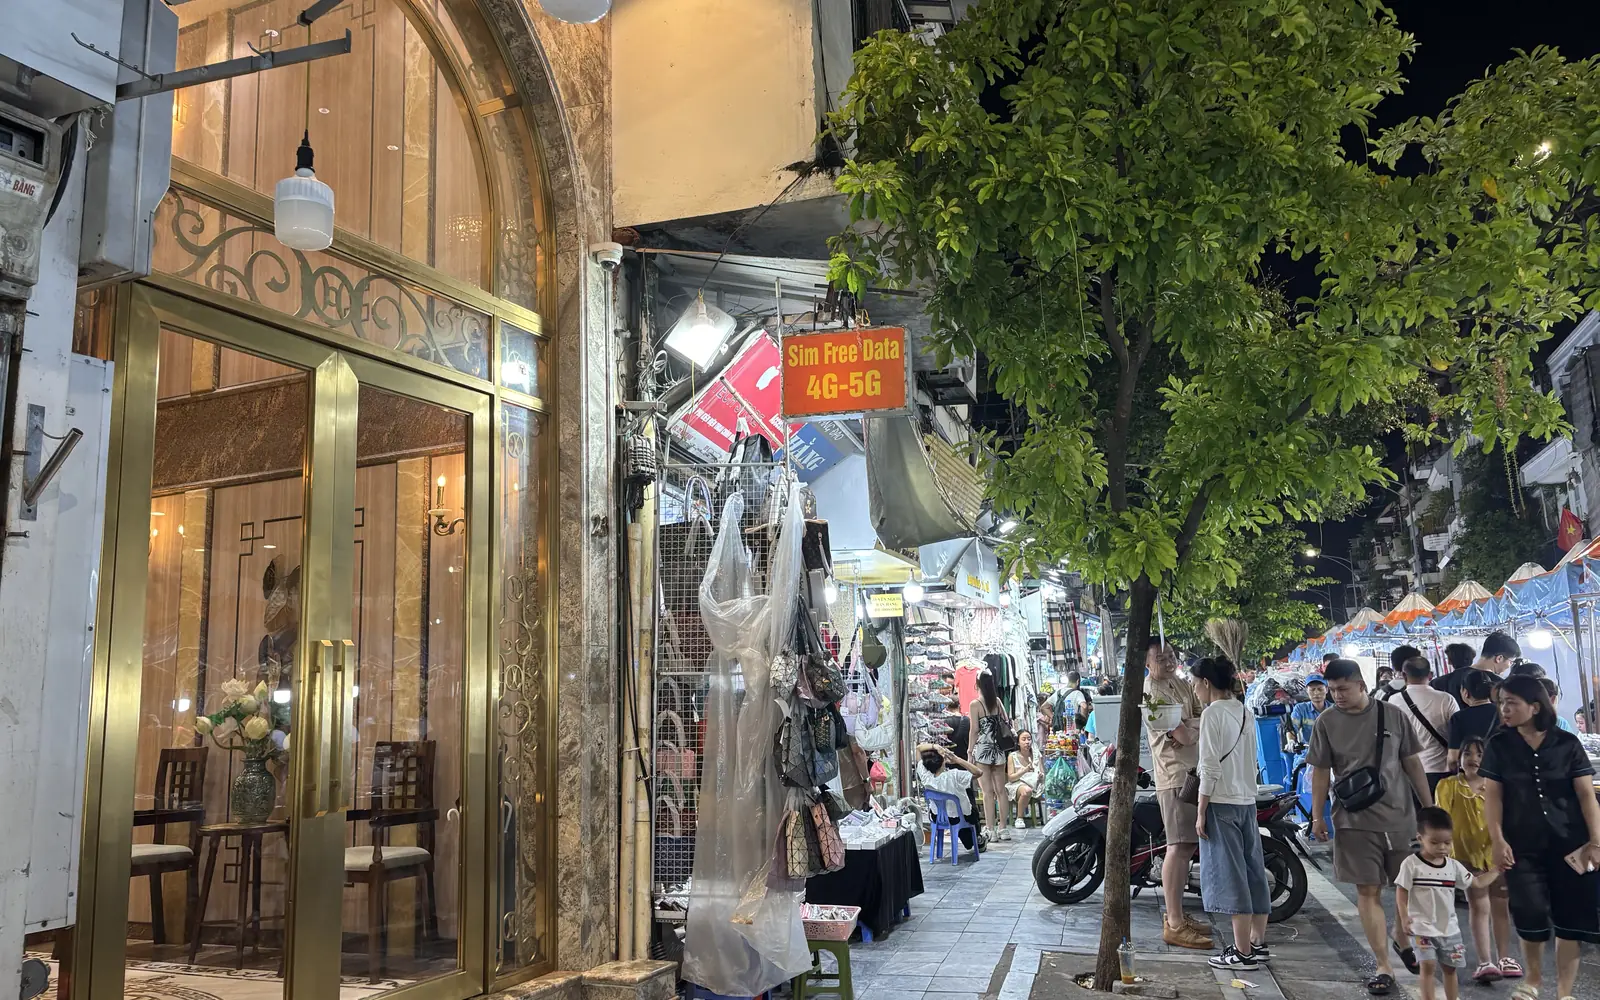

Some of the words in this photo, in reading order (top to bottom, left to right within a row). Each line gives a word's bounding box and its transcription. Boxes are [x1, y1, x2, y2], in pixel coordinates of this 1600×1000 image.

[788, 343, 819, 368] Sim
[824, 341, 858, 365] Free
[863, 338, 900, 361] Data
[807, 369, 881, 400] 4G-5G
